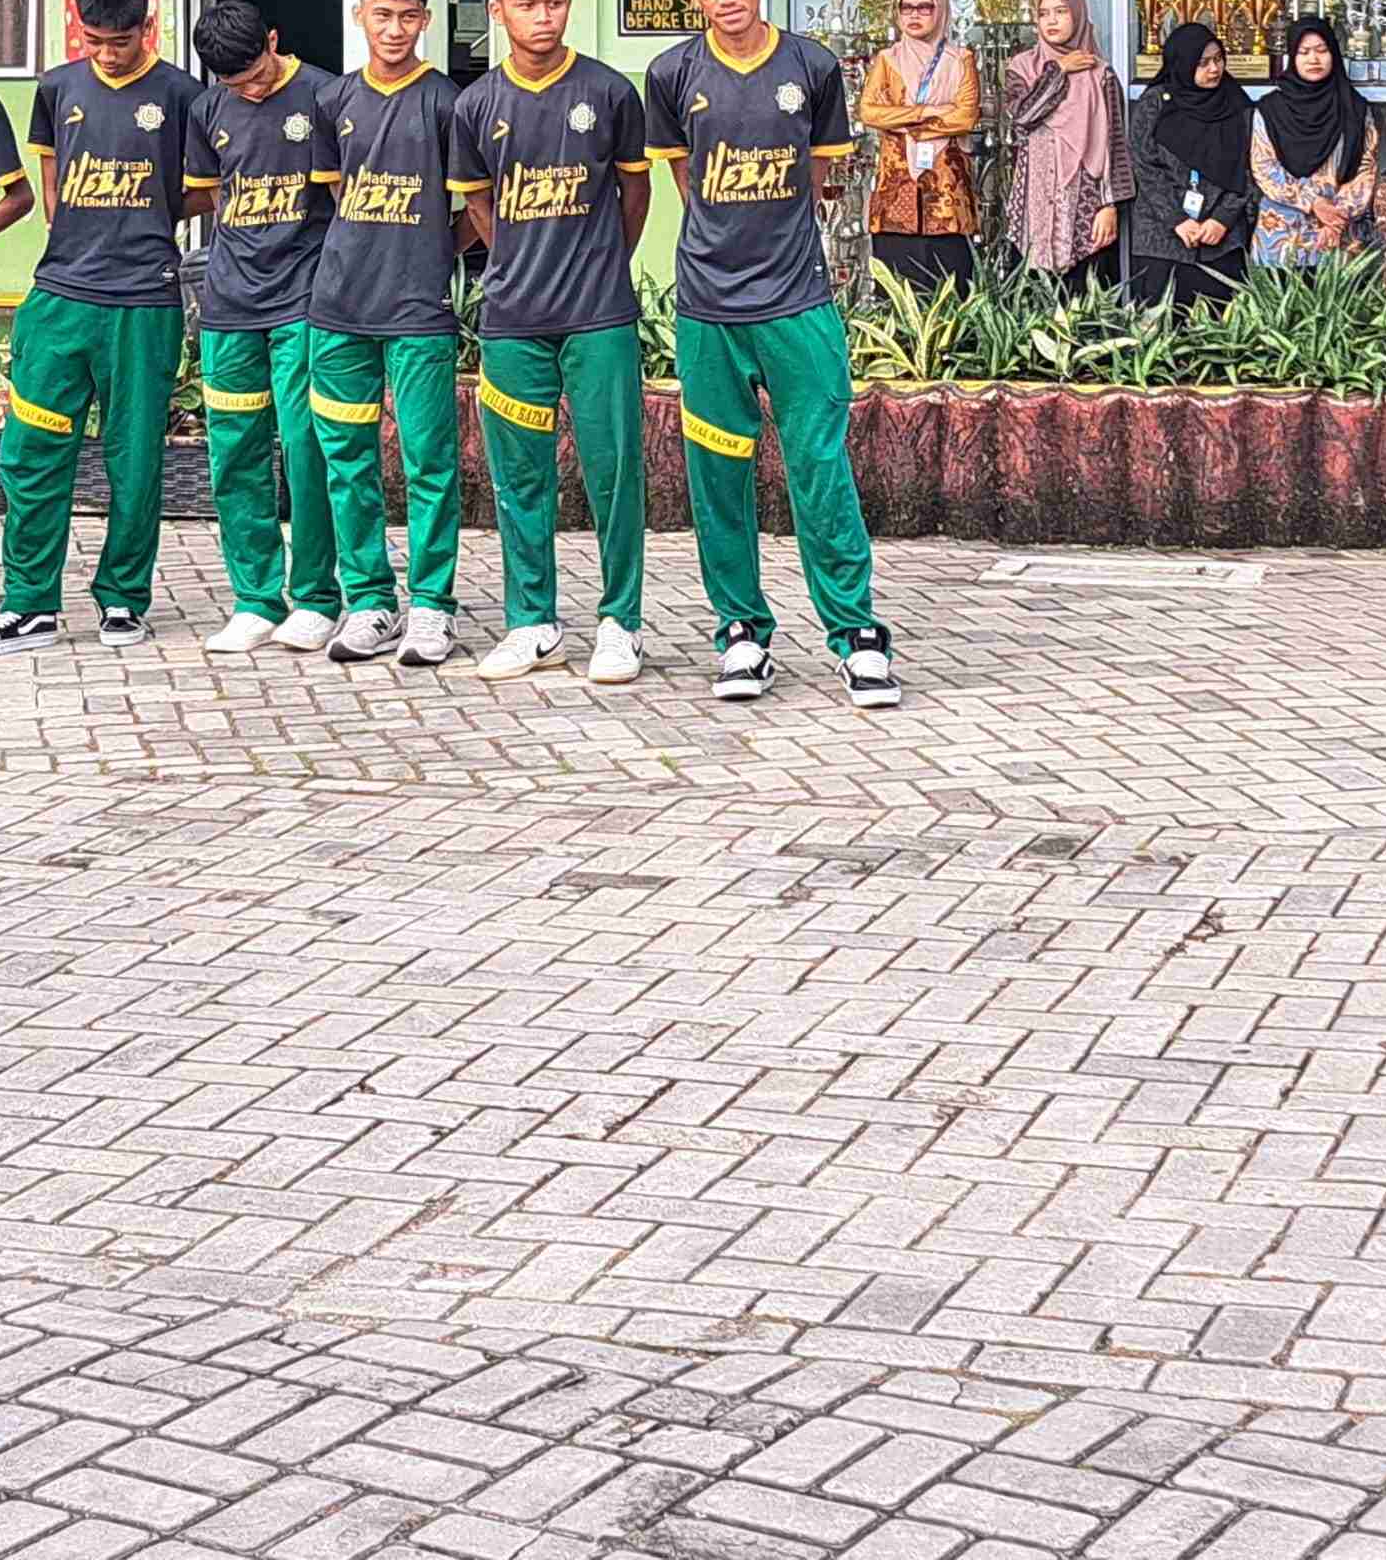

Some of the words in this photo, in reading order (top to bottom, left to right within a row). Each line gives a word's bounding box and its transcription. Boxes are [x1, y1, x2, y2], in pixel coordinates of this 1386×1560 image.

[626, 12, 679, 28] BEFORE
[524, 162, 588, 180] Madrasah
[727, 144, 797, 162] Madrasah
[61, 151, 151, 208] HEBAT
[241, 171, 305, 190] Madrasah
[362, 171, 422, 186] Madrasah
[702, 141, 796, 205] HEBAT
[221, 170, 305, 228] HEBAT
[340, 164, 421, 222] HEBAT
[497, 161, 588, 224] HEBAT
